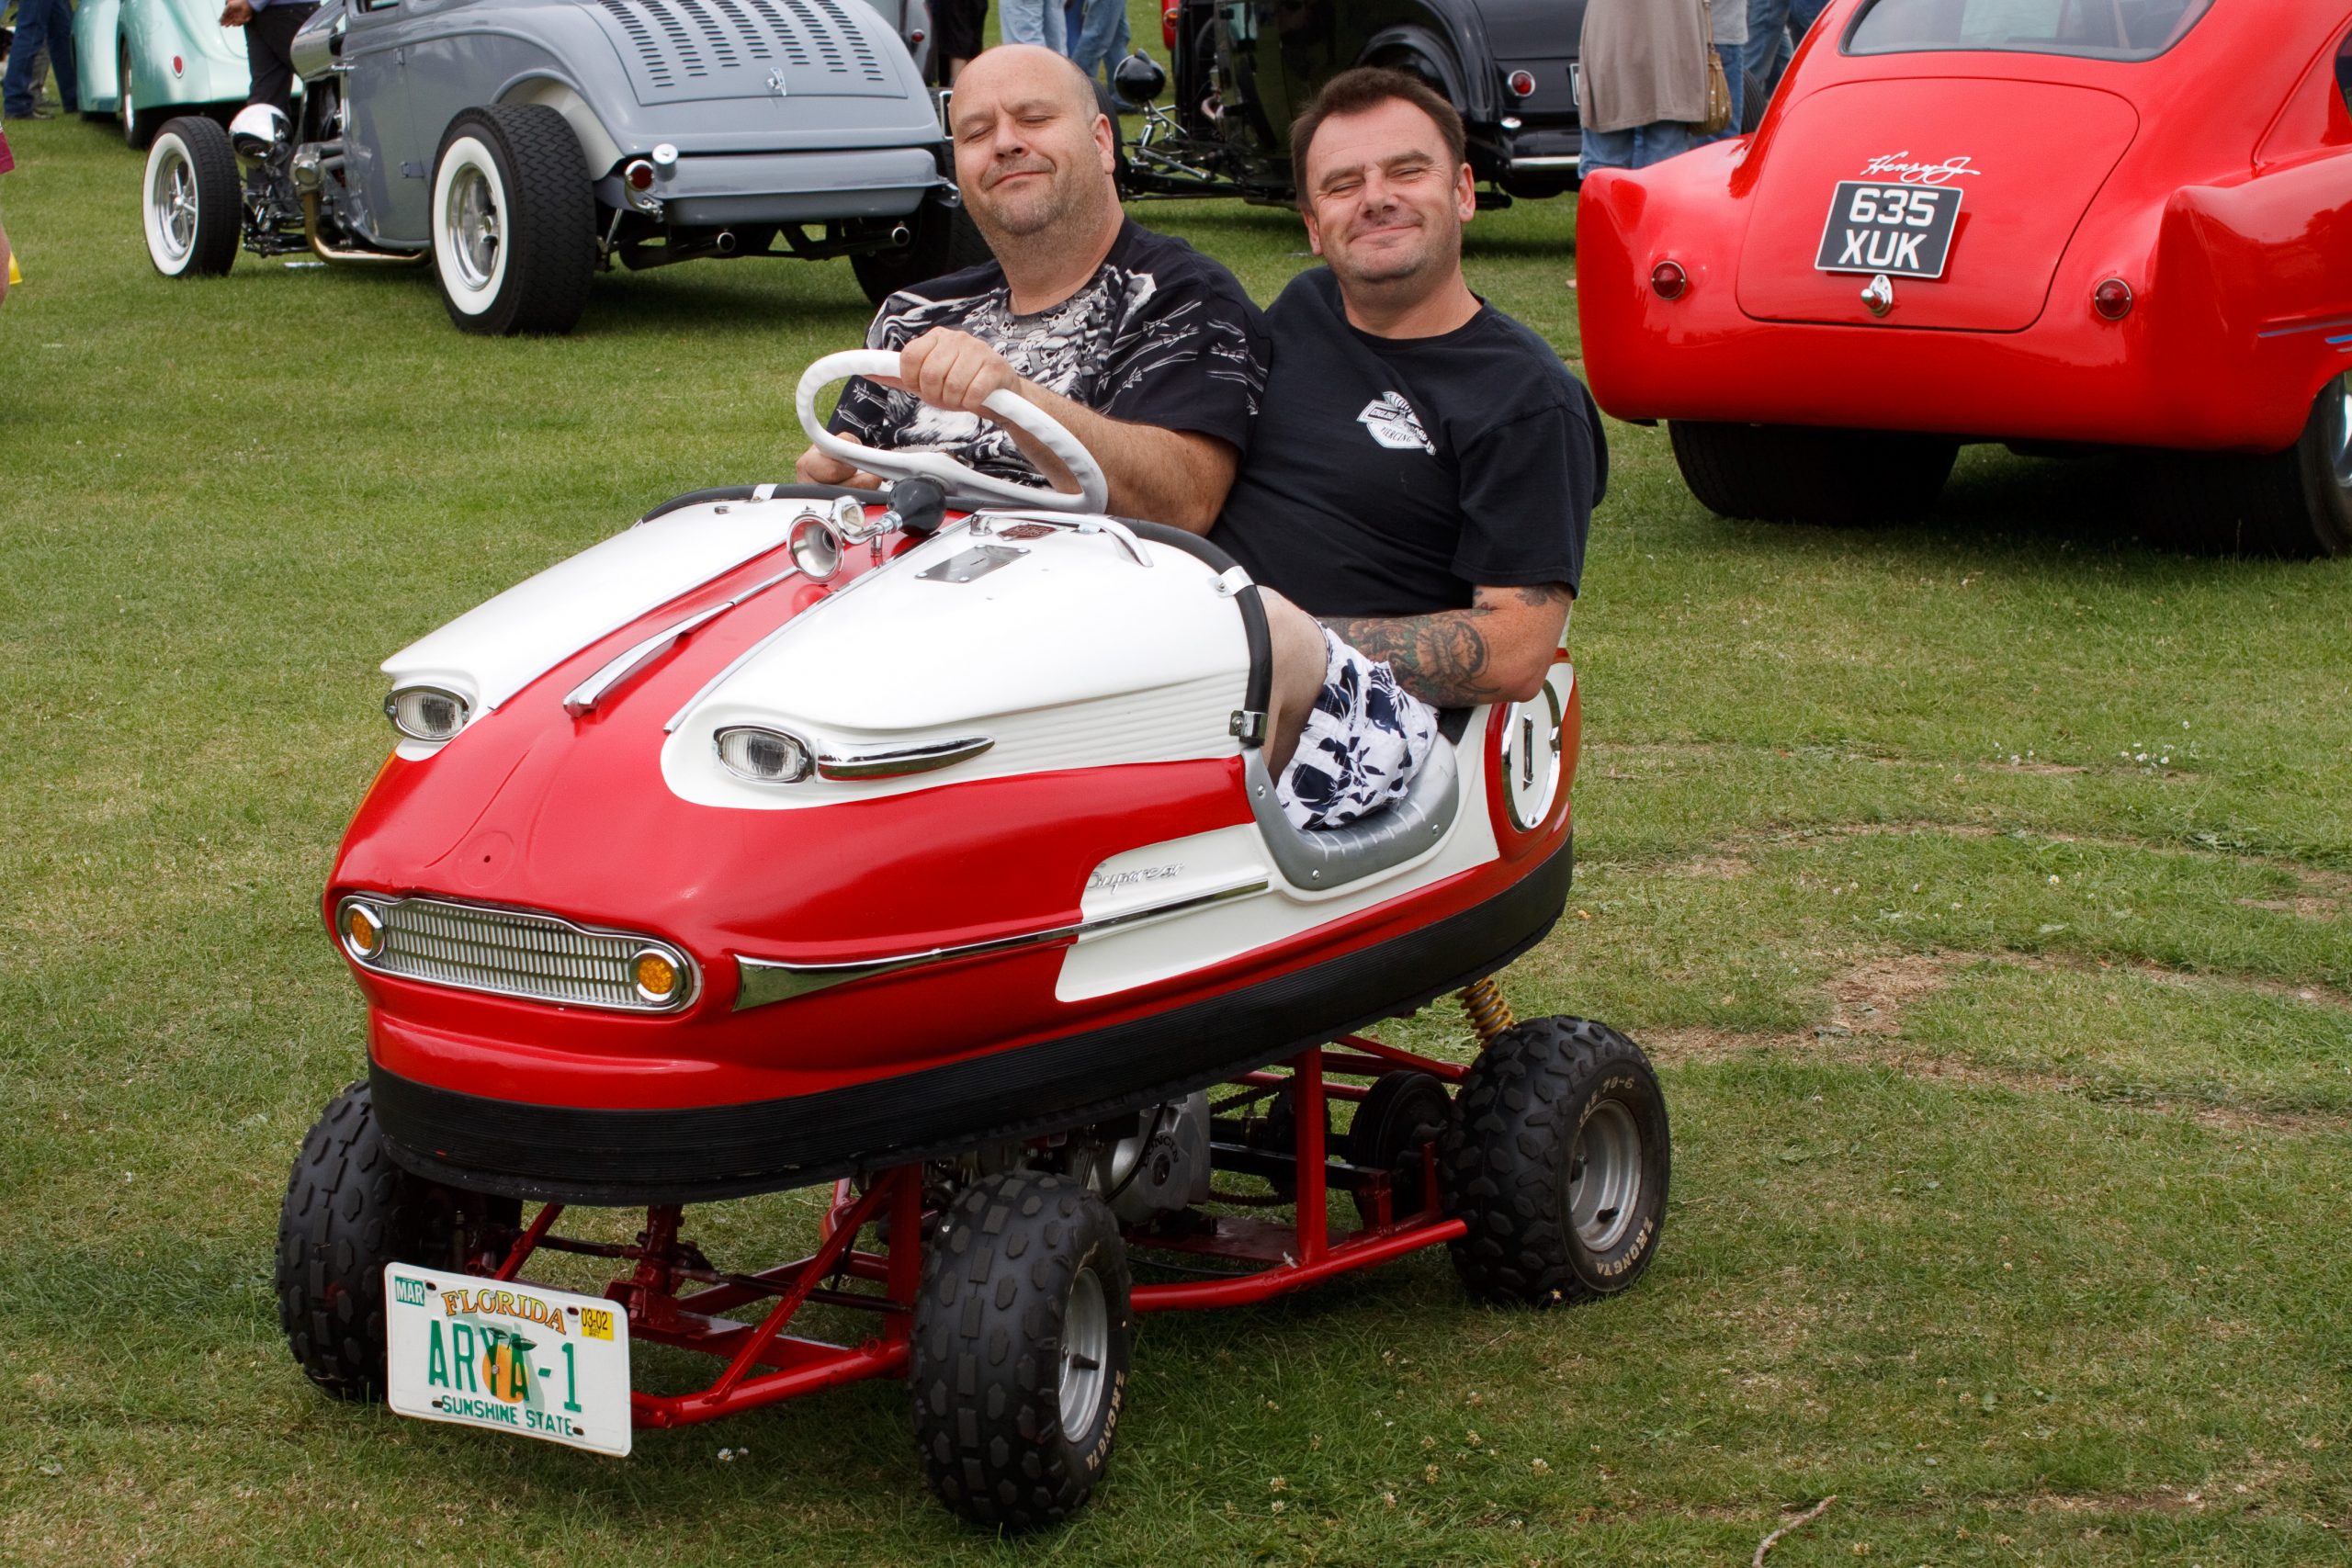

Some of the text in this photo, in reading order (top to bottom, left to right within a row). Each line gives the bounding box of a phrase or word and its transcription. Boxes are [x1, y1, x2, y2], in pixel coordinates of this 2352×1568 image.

[1849, 187, 1939, 227] 635
[1838, 229, 1928, 269] XUK
[396, 1280, 424, 1304] MAR
[441, 1289, 566, 1335] FLORIDA
[581, 1308, 608, 1330] 03-02
[428, 1319, 582, 1412] ARYA-1
[442, 1394, 574, 1437] SUNSHINE STATE
